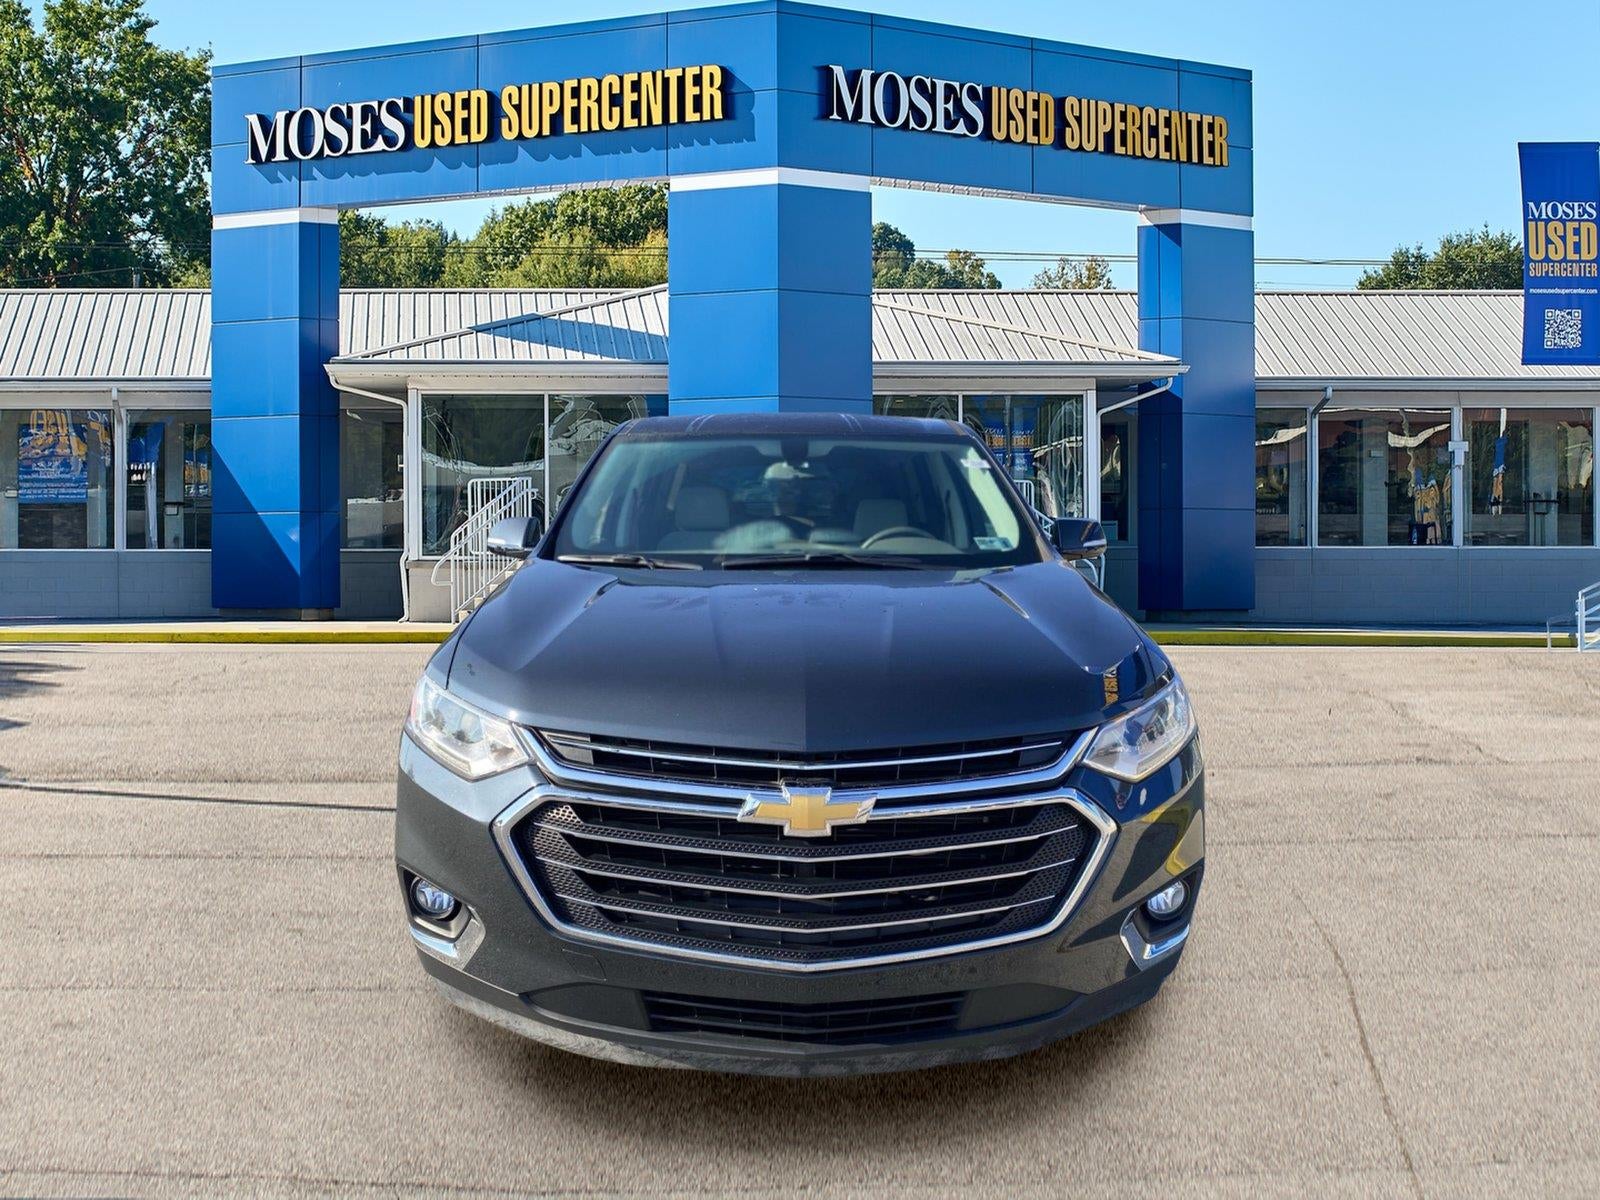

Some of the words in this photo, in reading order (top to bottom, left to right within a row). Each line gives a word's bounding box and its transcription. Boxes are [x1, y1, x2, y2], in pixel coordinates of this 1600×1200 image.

[245, 97, 407, 164] MOSES
[413, 89, 488, 148] USED
[501, 64, 724, 140] SUPERCENTER
[829, 65, 984, 137] MOSES
[991, 86, 1055, 146] USED
[1065, 96, 1229, 167] SUPERCENTER
[1527, 201, 1597, 219] MOSES
[1528, 221, 1598, 260] USED
[1529, 262, 1598, 277] SUPERCENTER
